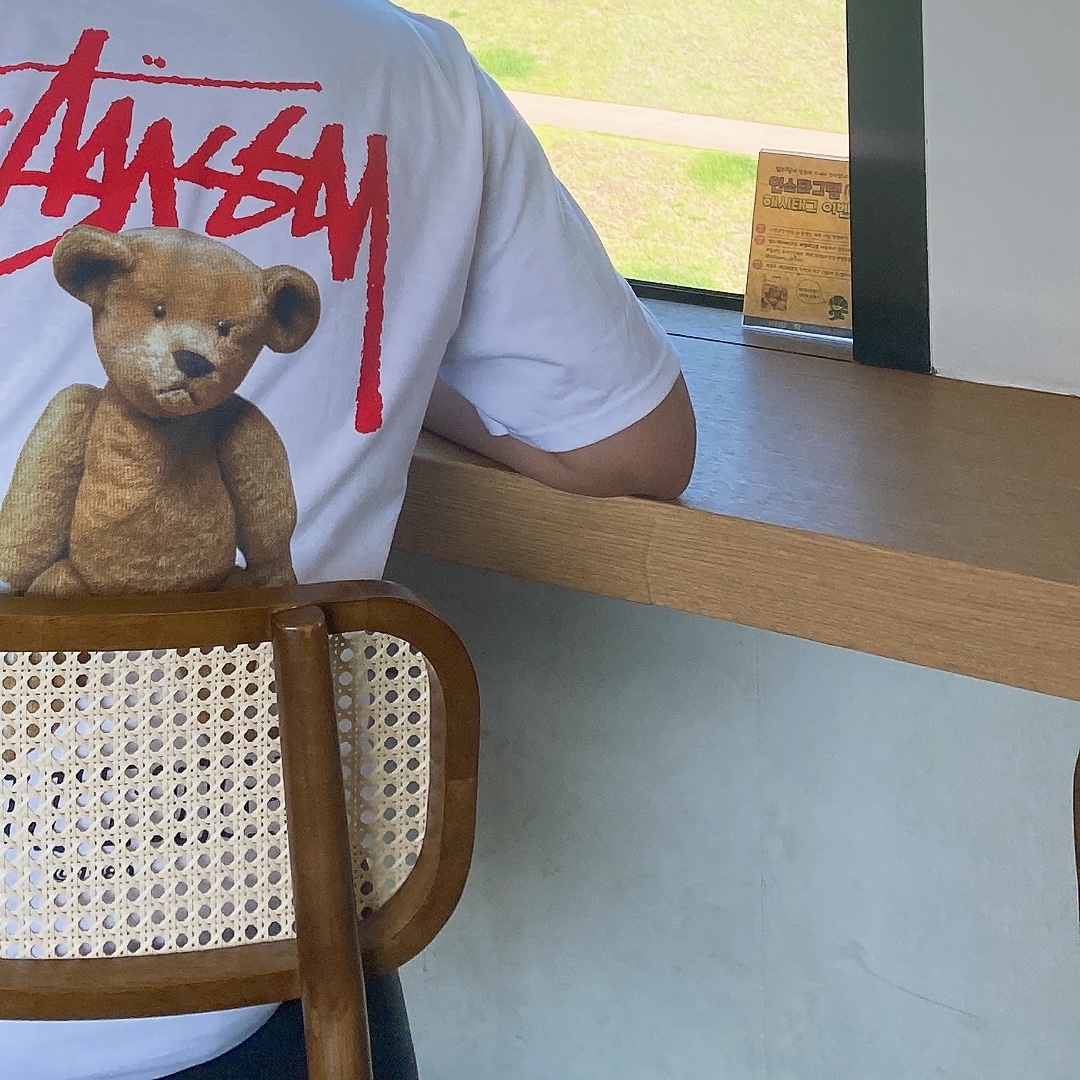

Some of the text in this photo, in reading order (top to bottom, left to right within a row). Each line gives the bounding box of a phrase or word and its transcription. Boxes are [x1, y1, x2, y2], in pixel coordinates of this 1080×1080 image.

[769, 176, 842, 200] 인스타그램
[763, 194, 850, 220] 해시태그 이벤
